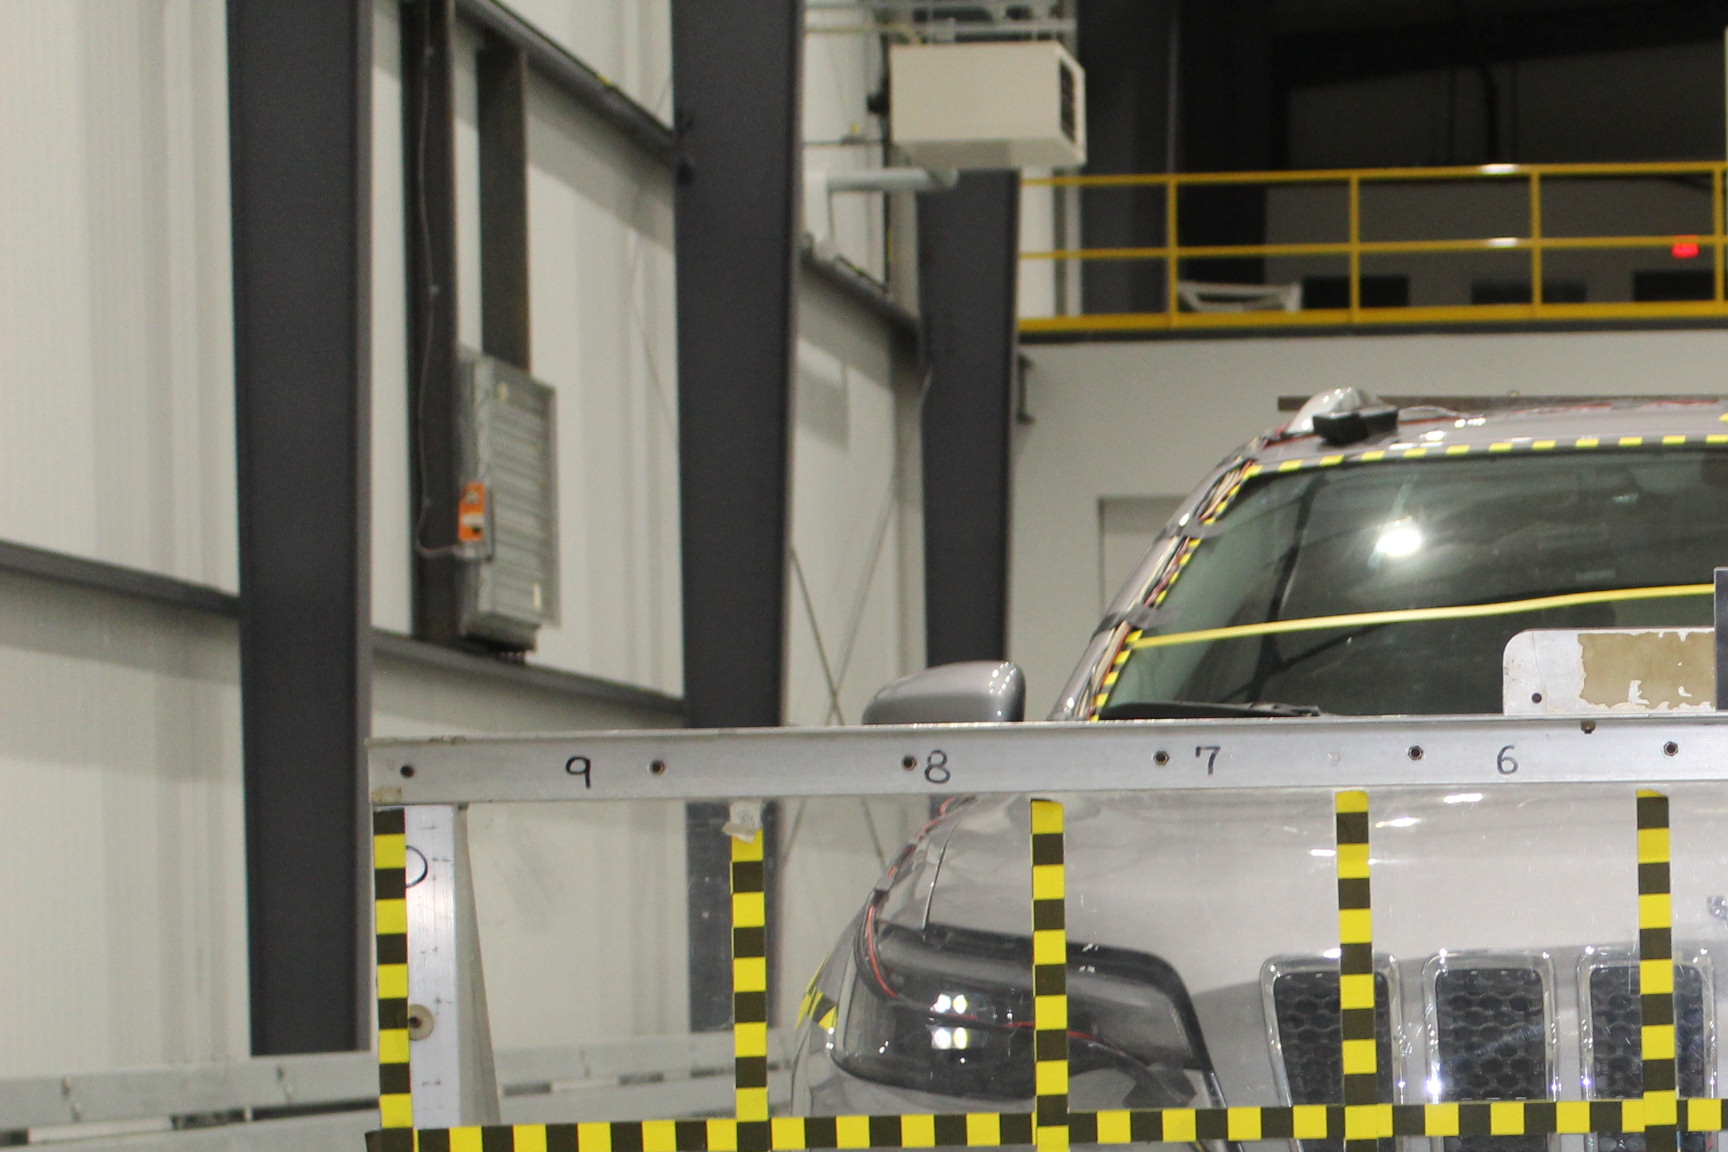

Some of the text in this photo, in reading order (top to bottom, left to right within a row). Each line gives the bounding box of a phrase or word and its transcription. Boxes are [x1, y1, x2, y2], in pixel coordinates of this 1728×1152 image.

[565, 755, 592, 789] 9
[924, 749, 951, 785] 8
[1194, 745, 1222, 776] 7
[1496, 744, 1519, 775] 6
